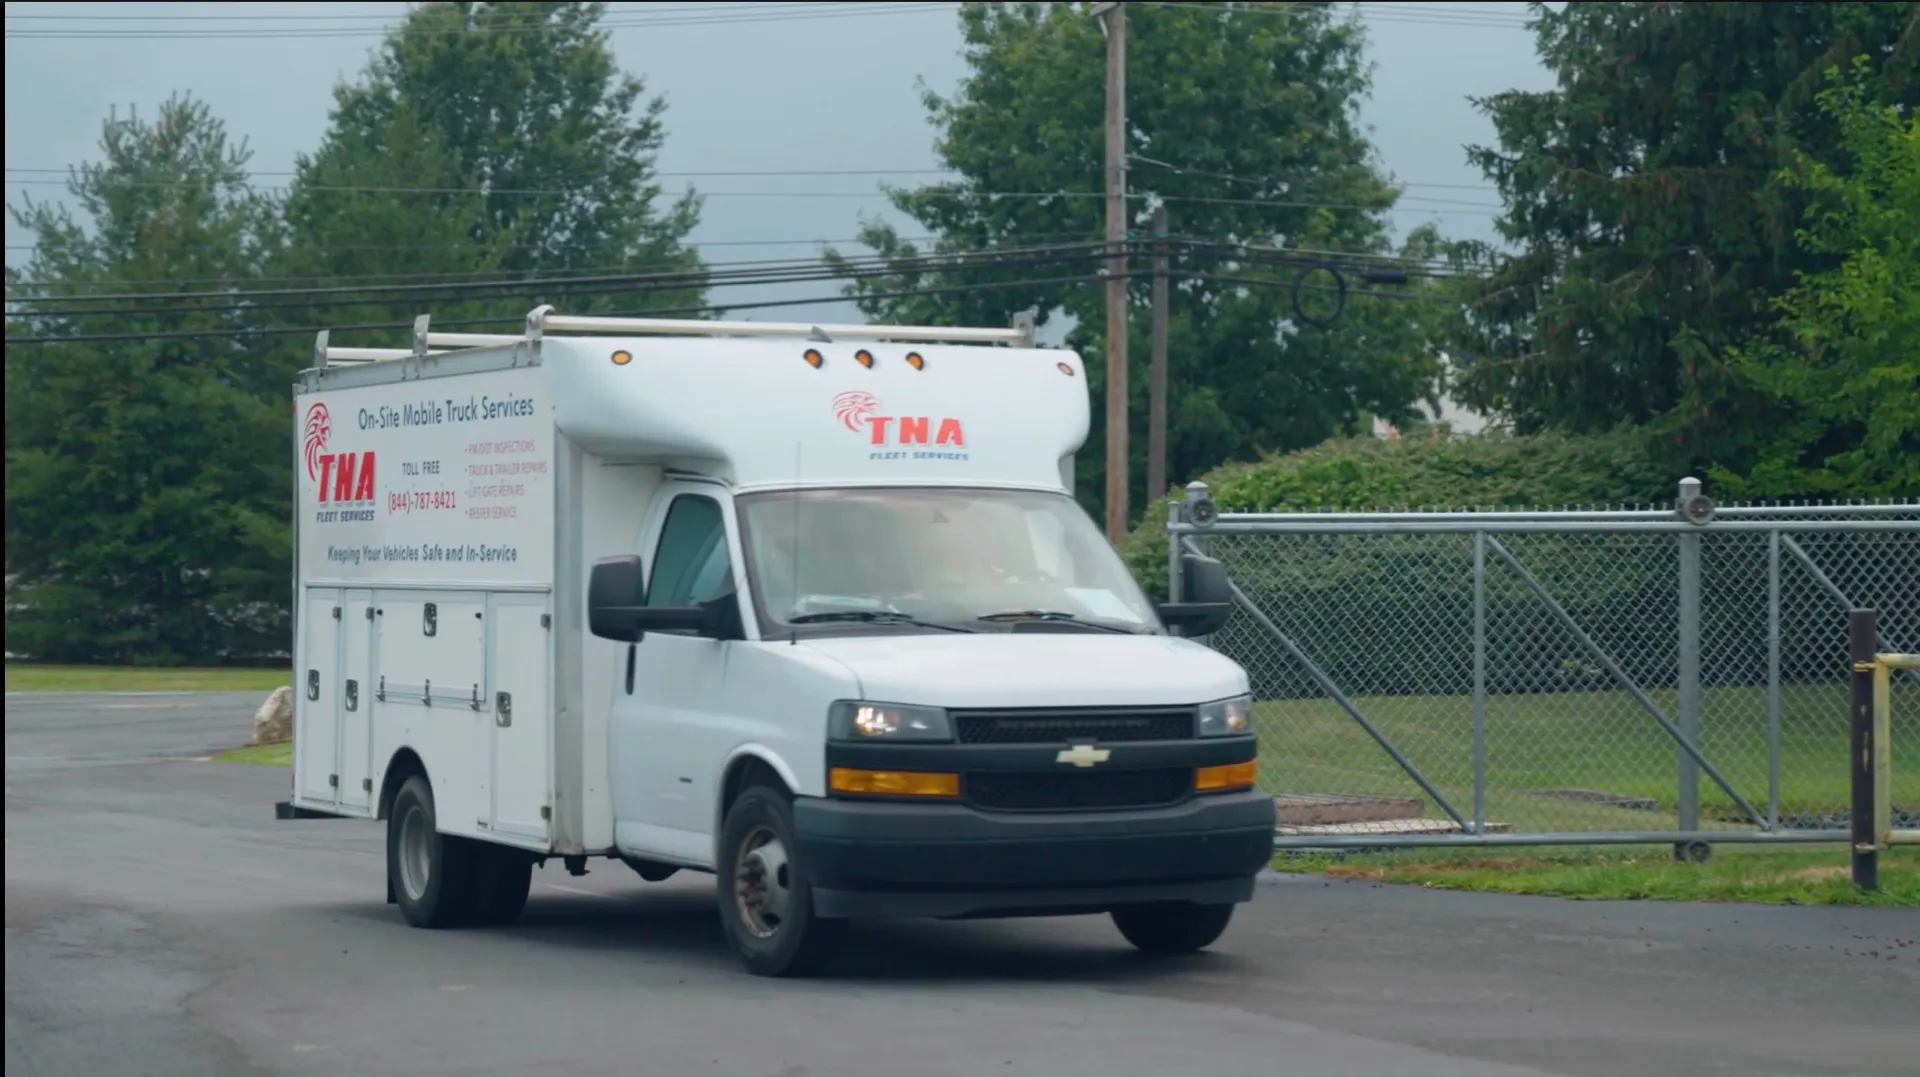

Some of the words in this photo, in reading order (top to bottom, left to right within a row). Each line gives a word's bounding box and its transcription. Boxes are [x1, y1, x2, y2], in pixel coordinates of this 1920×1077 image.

[359, 407, 400, 430] On-Site
[403, 400, 443, 426] Mobile
[445, 396, 478, 422] Truck
[481, 393, 534, 420] Services
[864, 416, 964, 445] TNA
[402, 462, 419, 476] TOLL
[423, 460, 440, 474] FREE
[869, 452, 907, 460] FLEET
[912, 451, 969, 461] SERVICES
[317, 451, 376, 503] TNA
[388, 489, 456, 515] (844)-787-8421
[316, 511, 338, 522] FLEET
[340, 510, 375, 521] SERVICES
[328, 545, 360, 565] Keeping
[362, 545, 381, 561] Your
[383, 545, 419, 561] Vehicles
[422, 543, 443, 561] Safe
[446, 545, 463, 561] and
[466, 543, 517, 561] In-Service
